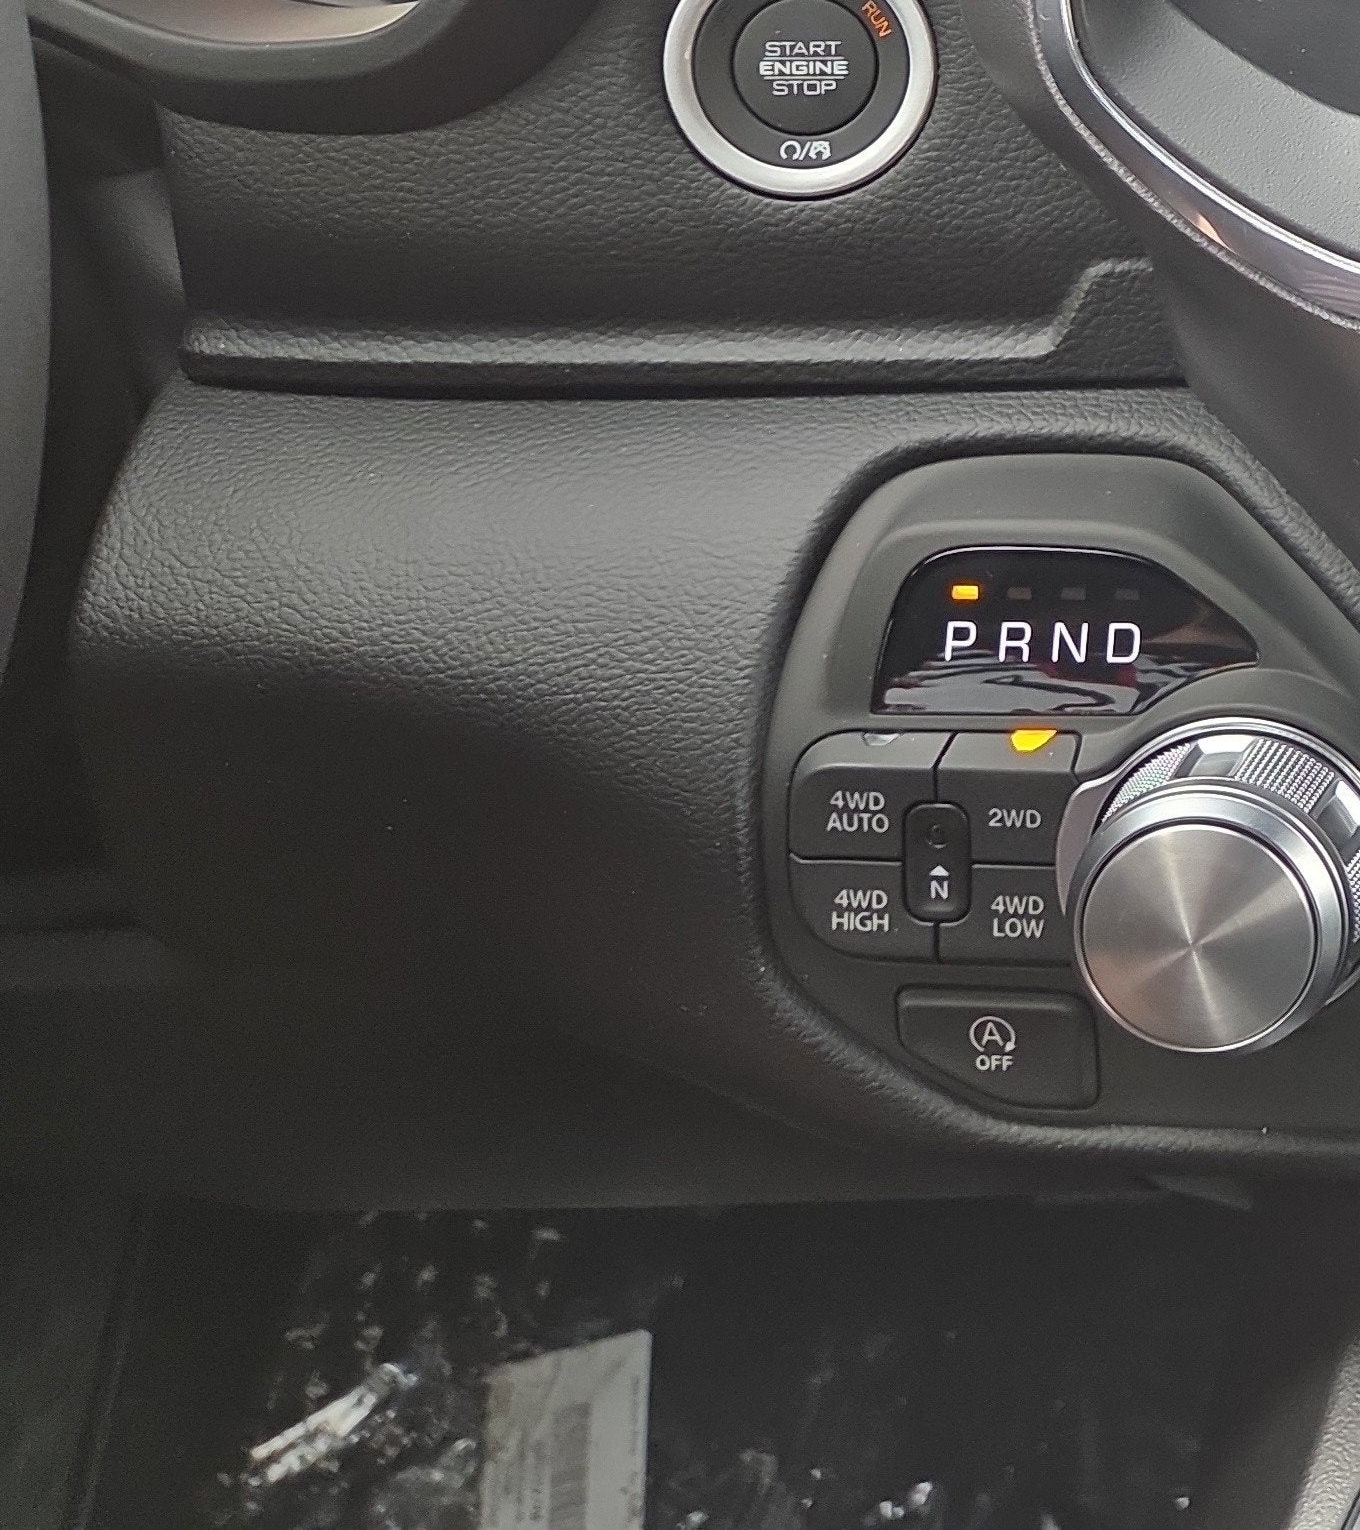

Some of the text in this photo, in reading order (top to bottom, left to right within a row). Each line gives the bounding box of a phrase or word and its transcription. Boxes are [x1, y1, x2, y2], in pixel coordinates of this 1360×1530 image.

[861, 0, 892, 38] RUN
[764, 41, 841, 57] START
[759, 60, 849, 75] ENGINE
[772, 80, 837, 96] STOP
[945, 621, 1141, 664] P R N D
[830, 790, 885, 811] 4WD
[826, 812, 889, 833] AUTO
[988, 808, 1042, 829] 2WD
[834, 889, 888, 909] 4WD
[930, 880, 949, 900] N
[990, 895, 1044, 915] 4WD
[831, 911, 889, 932] HIGH
[992, 918, 1044, 939] LOW
[976, 1055, 1013, 1071] OFF
